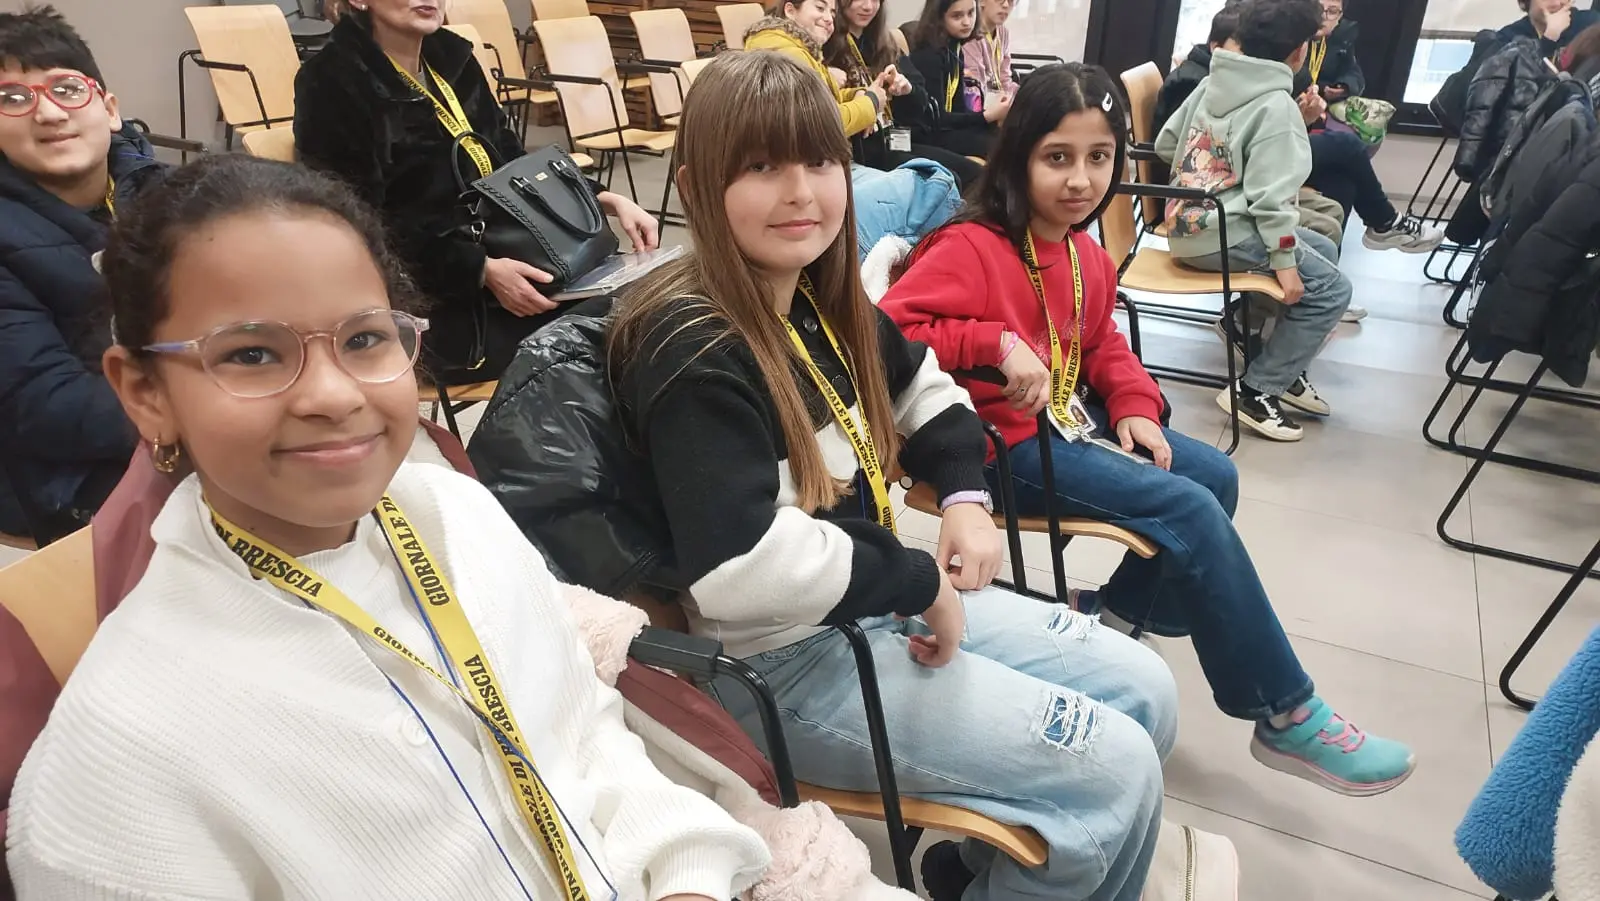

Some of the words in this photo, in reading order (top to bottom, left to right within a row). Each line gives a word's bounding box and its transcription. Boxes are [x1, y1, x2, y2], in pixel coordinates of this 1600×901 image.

[1068, 341, 1079, 377] BRESCIA
[843, 417, 854, 430] DI
[851, 430, 876, 480] BRESCIA
[231, 537, 323, 598] BRESCIA
[390, 516, 451, 607] GIORNALE
[463, 653, 514, 734] BRESCIA
[508, 760, 528, 782] DI
